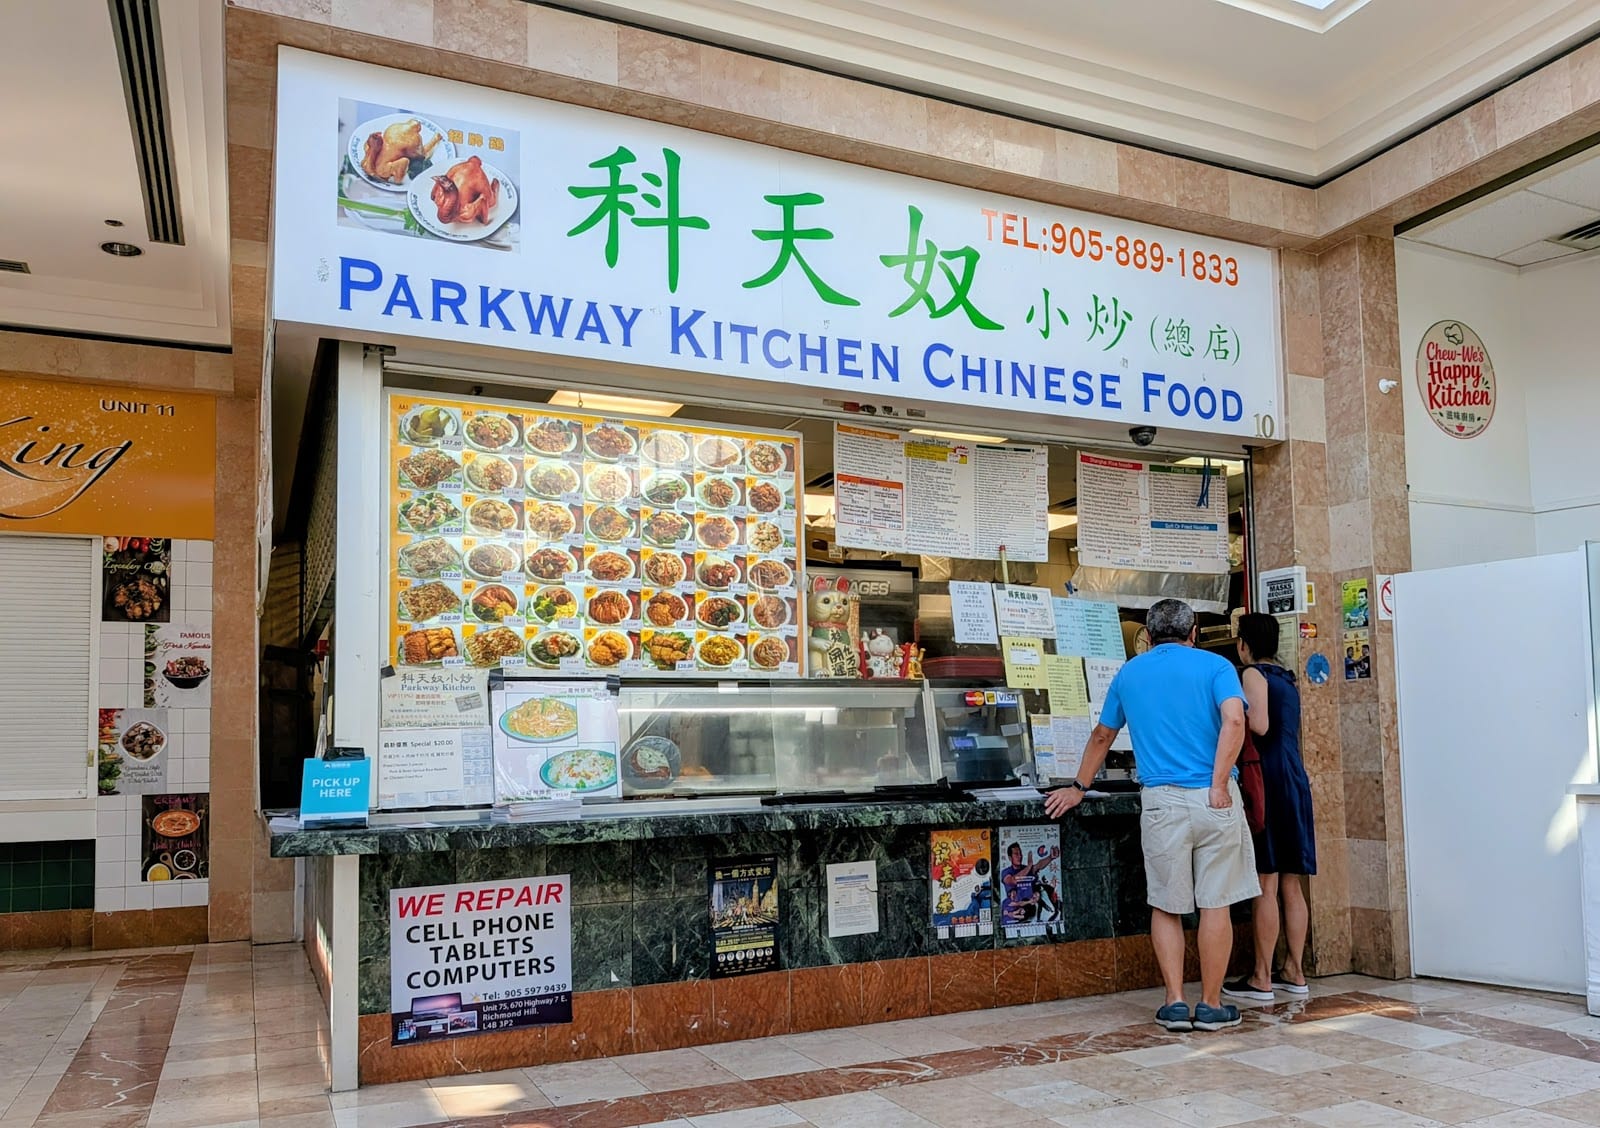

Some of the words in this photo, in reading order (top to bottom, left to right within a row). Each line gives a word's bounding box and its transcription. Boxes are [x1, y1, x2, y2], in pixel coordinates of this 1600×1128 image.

[567, 145, 1005, 331] 科天奴
[1025, 287, 1134, 351] 小炒
[980, 208, 1241, 287] TEL:905-889-1833
[338, 256, 643, 348] PARKWAY
[669, 305, 901, 383] KITCHEN
[922, 342, 1124, 411] CHINESE
[1142, 371, 1245, 423] FOOD
[1426, 341, 1485, 363] Chew-We's
[1427, 361, 1483, 388] Happy
[1427, 382, 1492, 410] Kitchen
[100, 399, 151, 414] UNIT
[155, 404, 176, 417] 11
[1253, 413, 1275, 439] 10
[1269, 583, 1292, 592] MASKS
[400, 672, 474, 684] 科天奴小炒
[401, 683, 440, 692] Parkway
[442, 683, 476, 691] Kitchen
[999, 693, 1017, 701] VISA
[312, 778, 341, 788] PICK
[343, 777, 361, 787] UP
[320, 788, 352, 798] HERE
[397, 893, 446, 919] WE
[454, 883, 564, 913] REPAIR
[406, 921, 465, 944] CELL
[473, 912, 555, 937] PHONE
[429, 936, 534, 964] TABLETS
[406, 956, 556, 990] COMPUTERS
[482, 992, 501, 1001] Tel:
[504, 989, 522, 999] 905
[524, 986, 542, 996] 597
[544, 983, 567, 993] 9439
[482, 1003, 498, 1013] Unit
[498, 1002, 509, 1012] 75,
[509, 1000, 524, 1009] 670
[523, 996, 554, 1007] Highway
[560, 995, 568, 1003] E.
[482, 1010, 522, 1022] Richmond
[499, 1019, 514, 1029] 3P2
